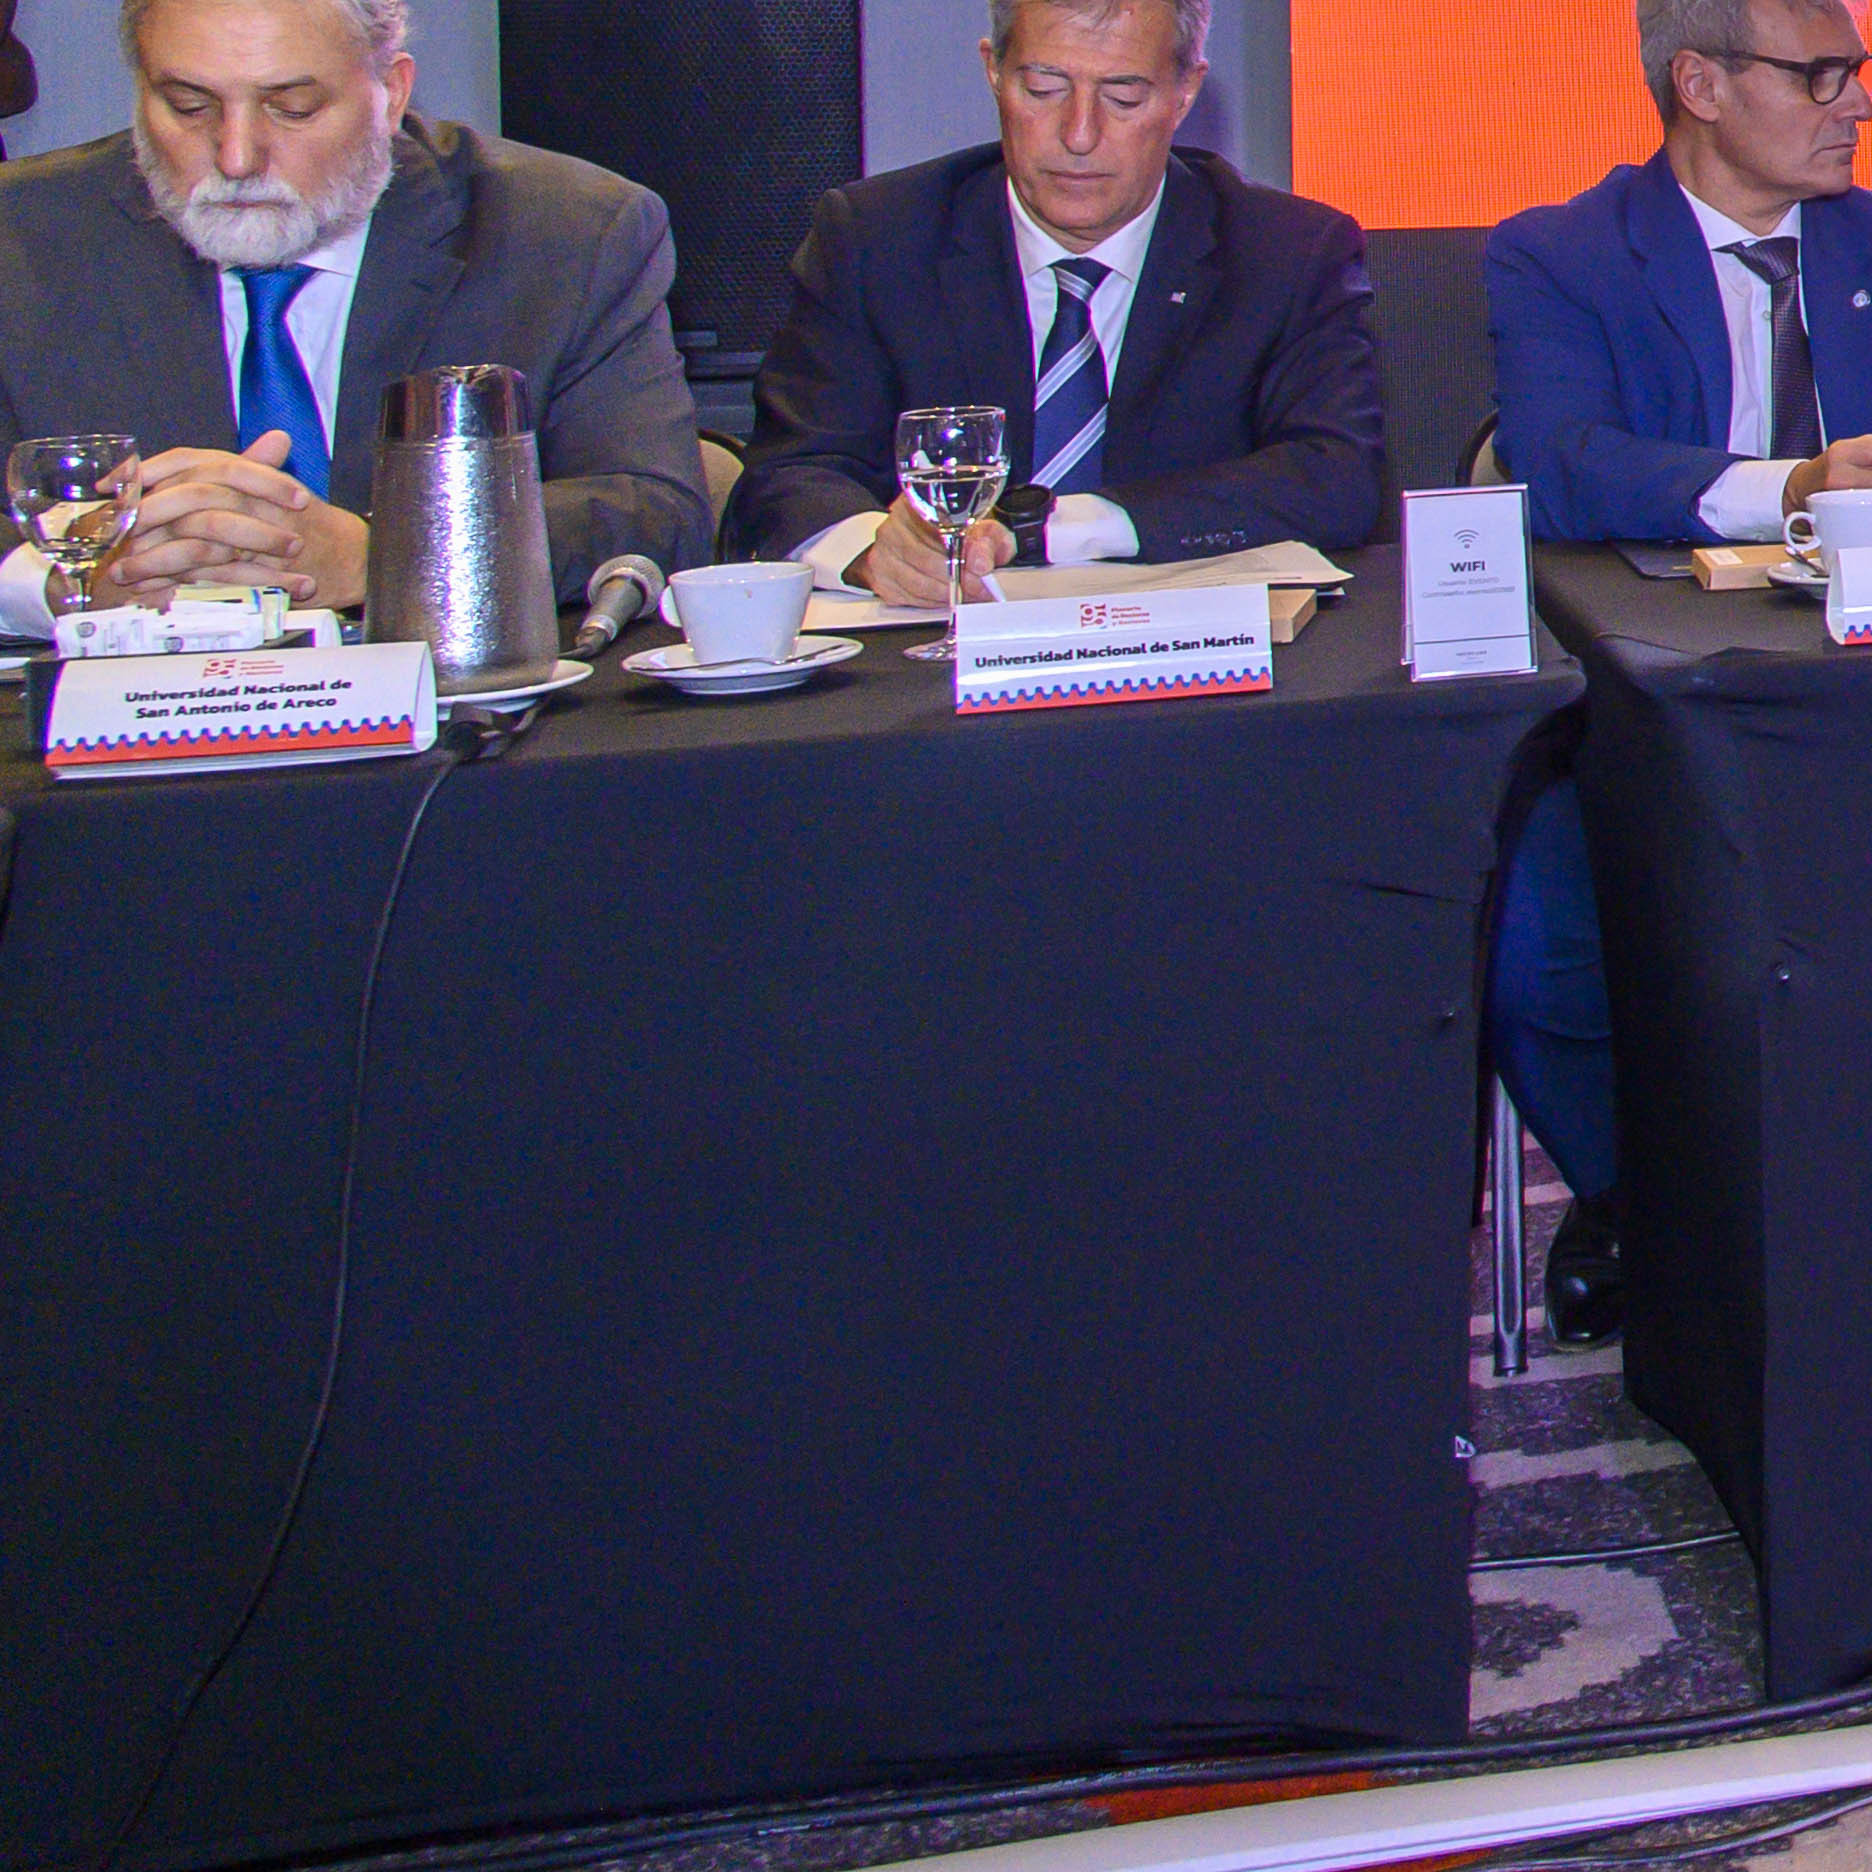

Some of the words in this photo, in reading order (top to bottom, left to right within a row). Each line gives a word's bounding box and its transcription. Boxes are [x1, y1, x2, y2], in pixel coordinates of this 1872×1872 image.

[1449, 560, 1486, 573] WIFI
[975, 649, 1073, 669] Universidad
[1076, 642, 1147, 660] Nacional
[1150, 641, 1170, 654] de
[1172, 639, 1201, 652] San
[1203, 633, 1255, 649] Martín
[124, 684, 241, 703] Universidad
[243, 680, 326, 696] Nacional
[330, 679, 353, 690] de
[135, 706, 170, 720] San
[174, 702, 252, 718] Antonio
[255, 699, 278, 712] de
[283, 696, 338, 710] Areco
